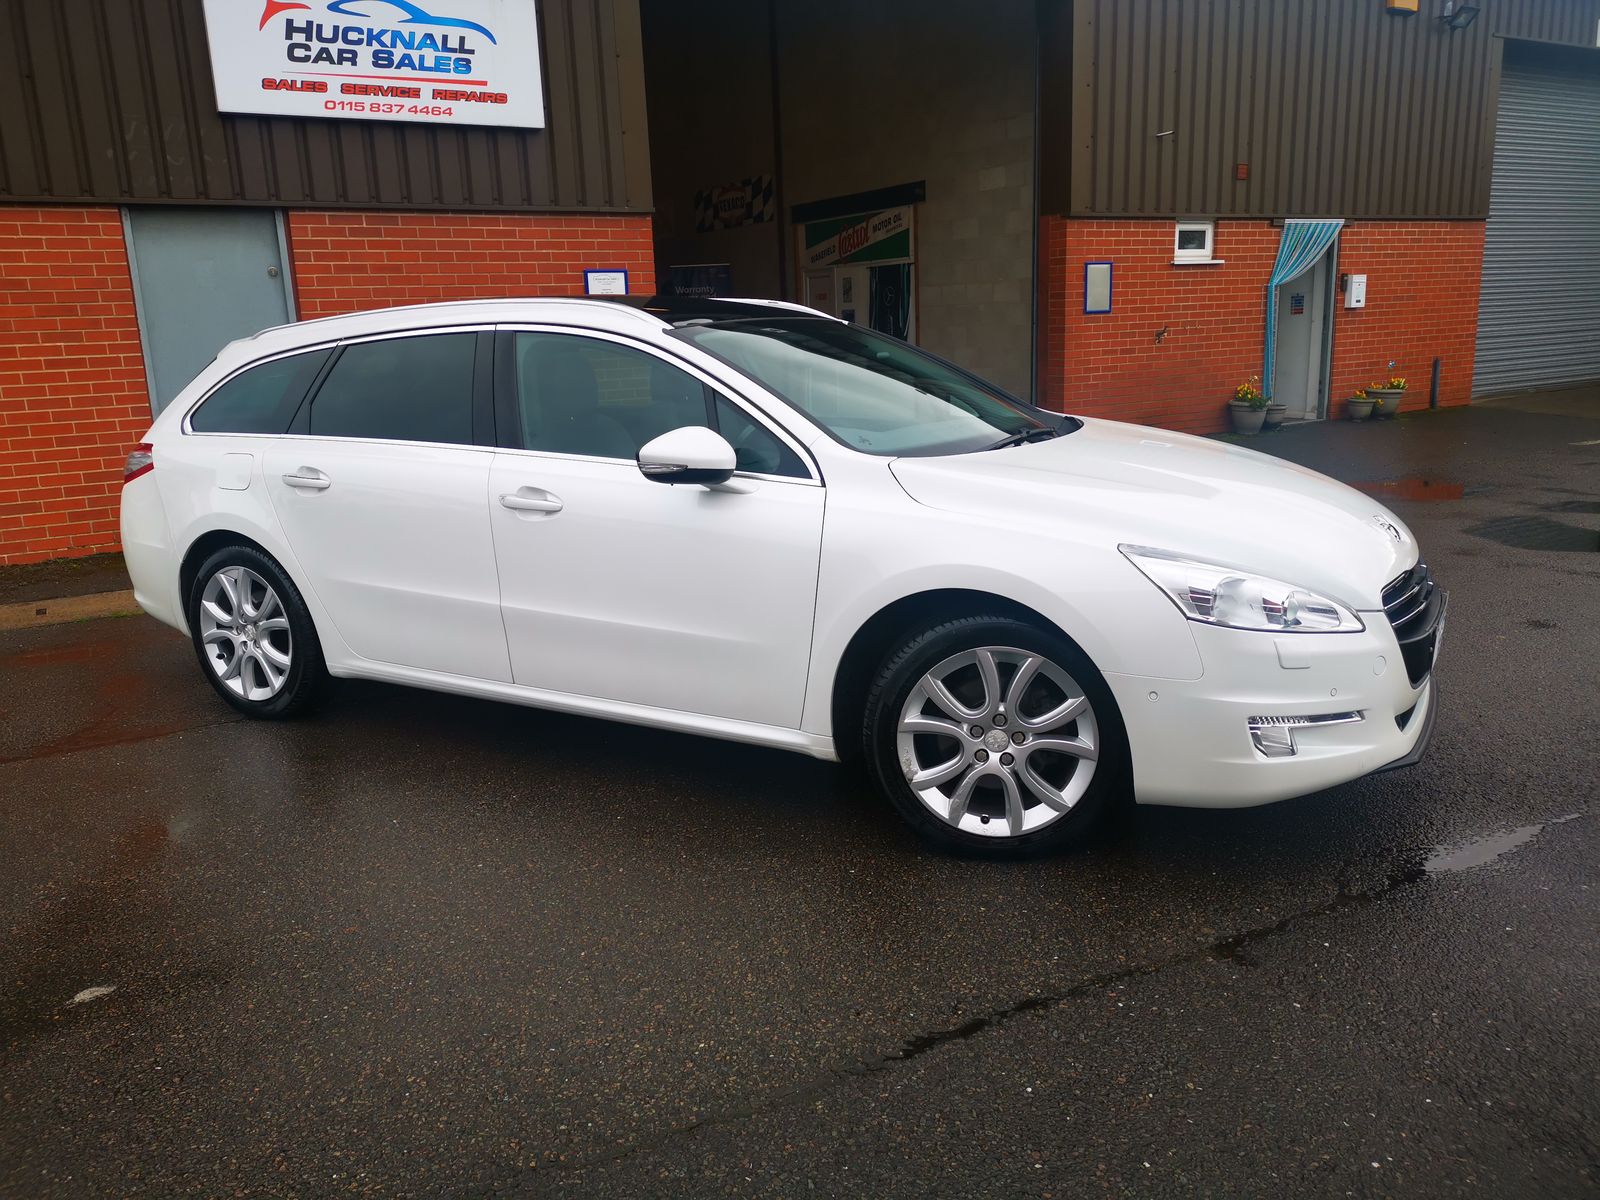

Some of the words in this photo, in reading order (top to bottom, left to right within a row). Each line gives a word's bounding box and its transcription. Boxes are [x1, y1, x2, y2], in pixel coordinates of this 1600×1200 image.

[285, 18, 475, 55] HUCKNALL
[286, 42, 358, 67] CAR
[371, 49, 472, 75] SALES
[261, 77, 328, 93] SALES
[340, 82, 421, 100] SERVICE
[432, 88, 508, 105] REPAIRS
[324, 99, 366, 113] 0115
[369, 102, 405, 114] 837
[407, 104, 453, 117] 4464
[872, 217, 892, 234] MOTOR
